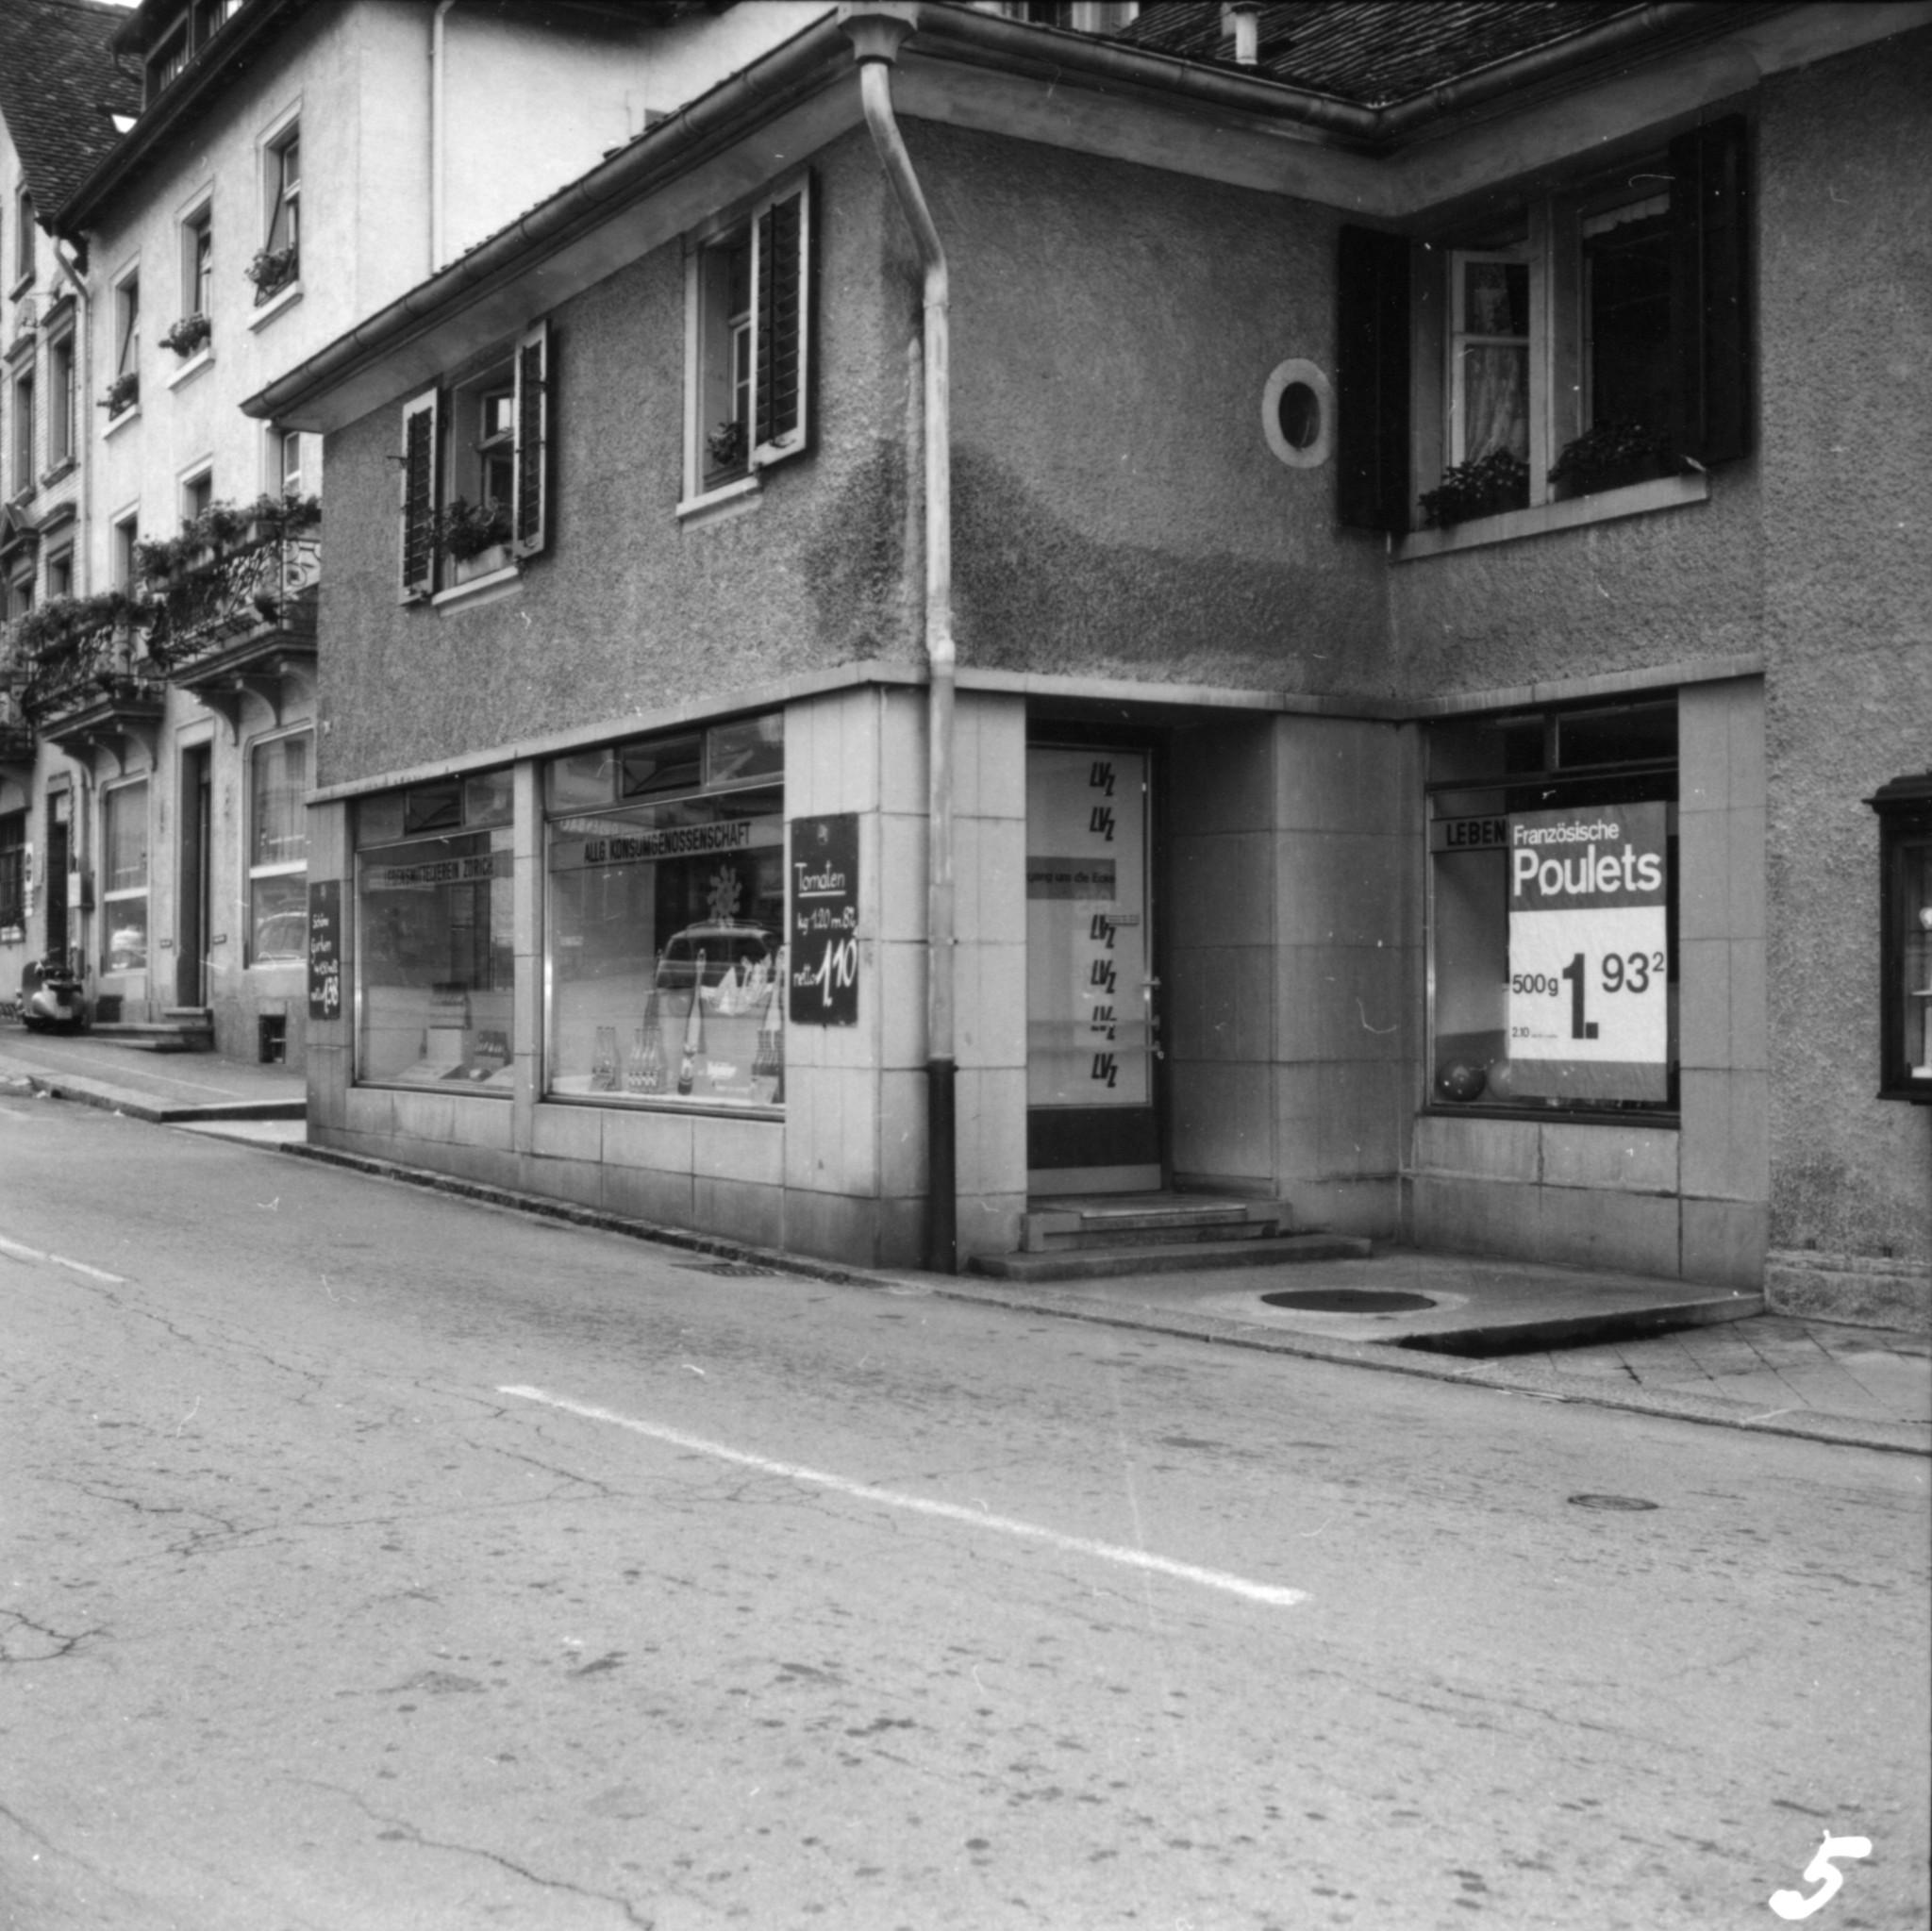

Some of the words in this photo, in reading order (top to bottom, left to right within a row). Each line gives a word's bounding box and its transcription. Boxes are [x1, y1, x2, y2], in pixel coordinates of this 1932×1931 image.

[584, 841, 607, 863] ALLG.
[609, 822, 751, 859] KONSUMGENOSSENSCHAFT
[1446, 820, 1507, 846] LEBEN
[1513, 820, 1620, 846] Französische
[794, 860, 845, 891] Tomaten
[1513, 844, 1662, 896] Poulets
